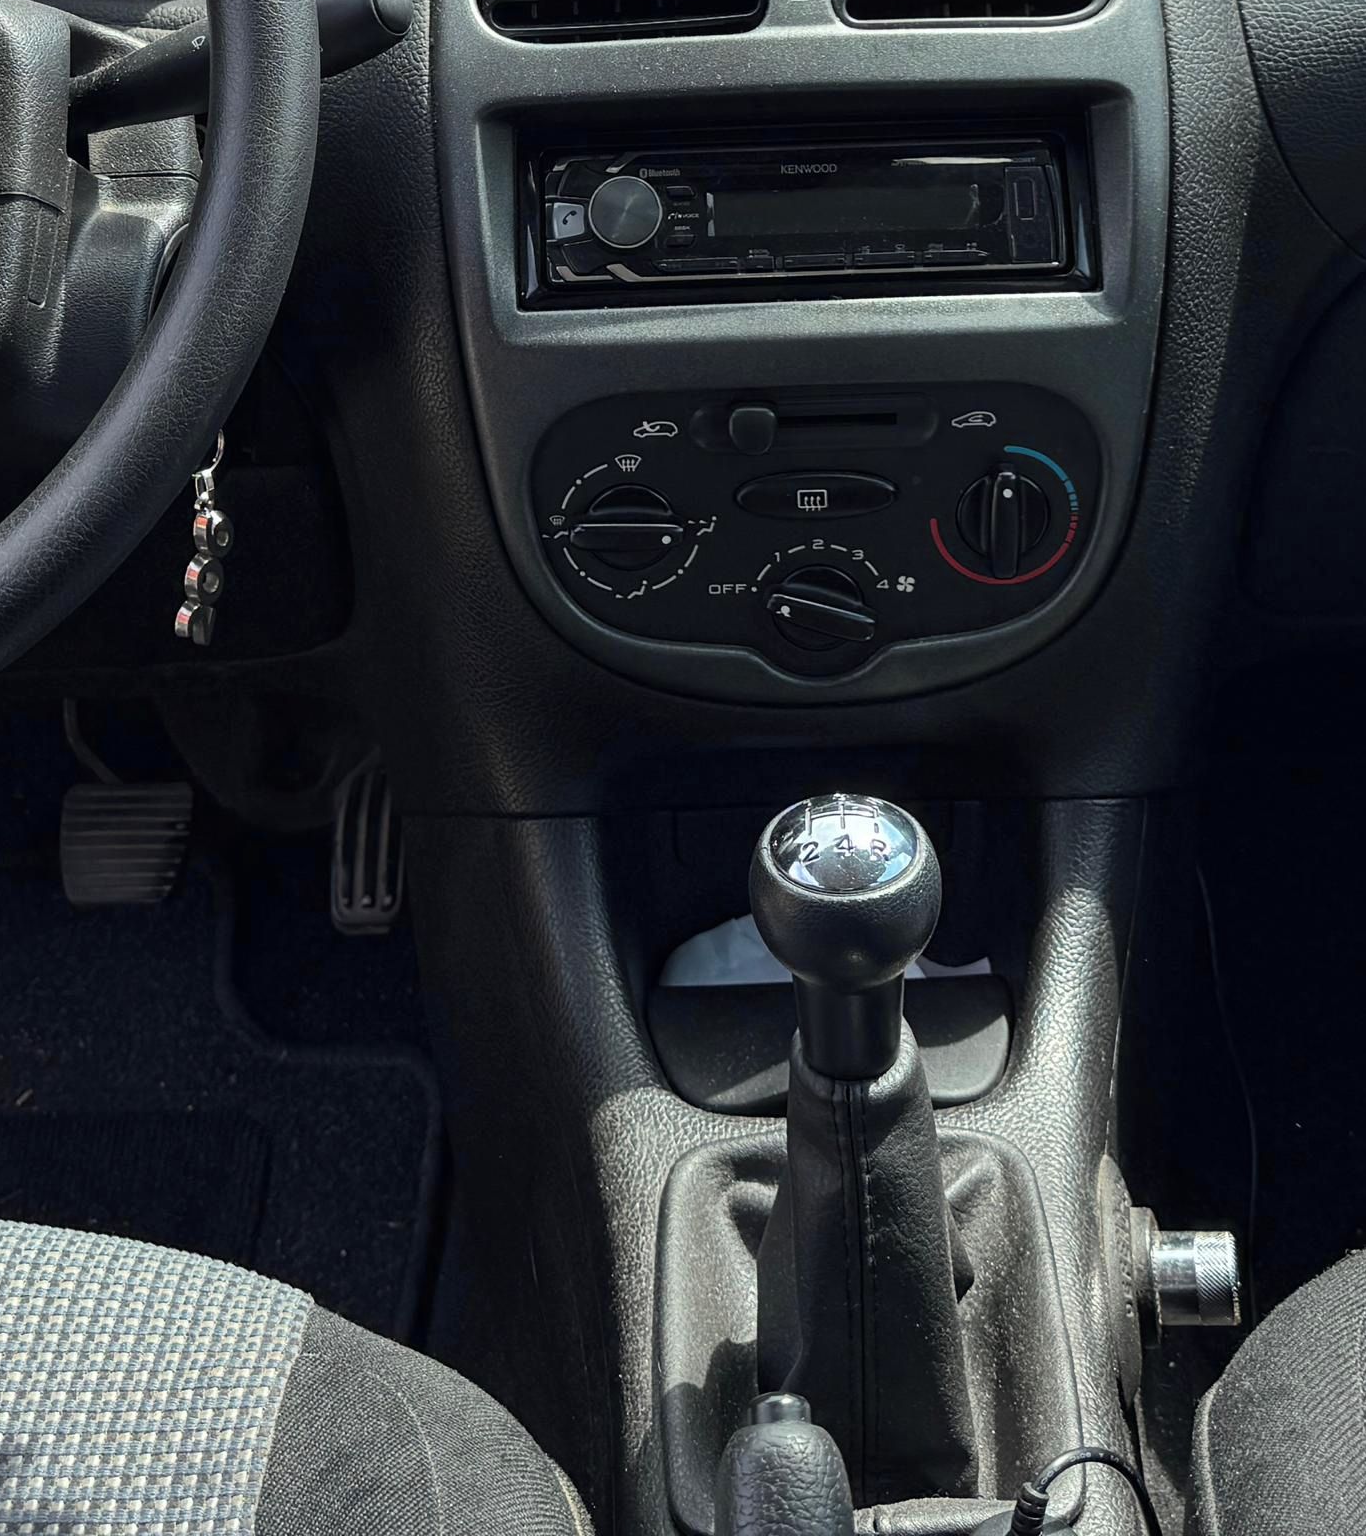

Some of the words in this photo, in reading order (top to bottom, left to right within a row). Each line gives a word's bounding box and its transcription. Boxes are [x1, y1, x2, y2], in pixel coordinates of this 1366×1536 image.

[648, 168, 681, 177] Bluetooth
[780, 164, 837, 174] KENWOOD
[709, 583, 747, 595] OFF
[774, 551, 781, 562] 1
[812, 539, 825, 550] 2
[852, 549, 864, 560] 3
[876, 579, 889, 589] 4
[800, 841, 820, 864] 2
[834, 834, 855, 856] 4
